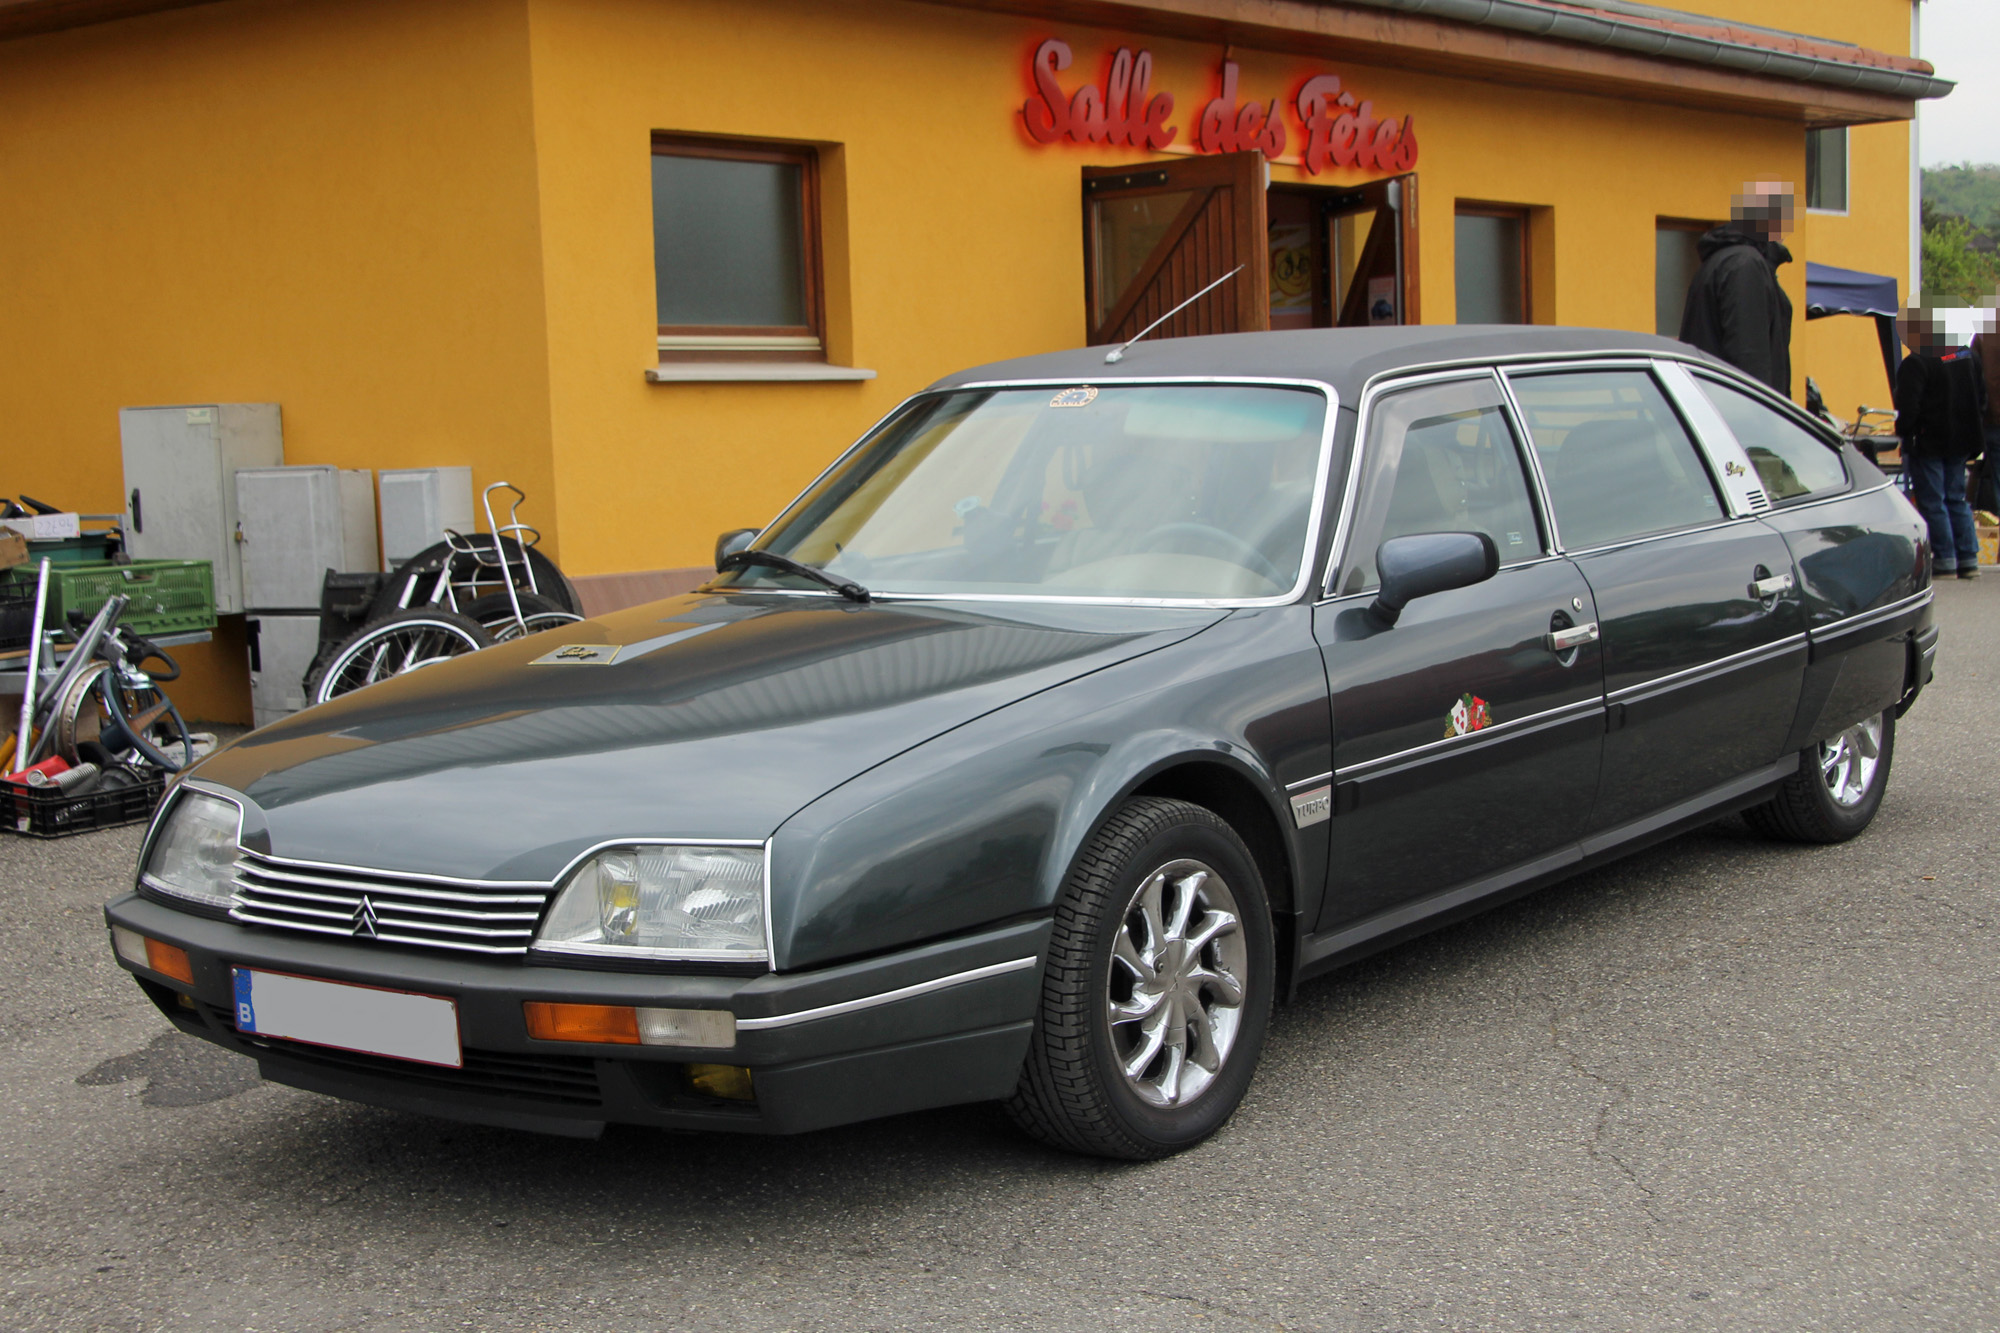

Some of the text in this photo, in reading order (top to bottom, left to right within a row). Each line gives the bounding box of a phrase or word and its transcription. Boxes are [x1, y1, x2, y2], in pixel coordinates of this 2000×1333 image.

[1023, 38, 1418, 176] Salle des Fêtes
[1295, 796, 1329, 820] TURBO
[238, 1002, 252, 1023] B
